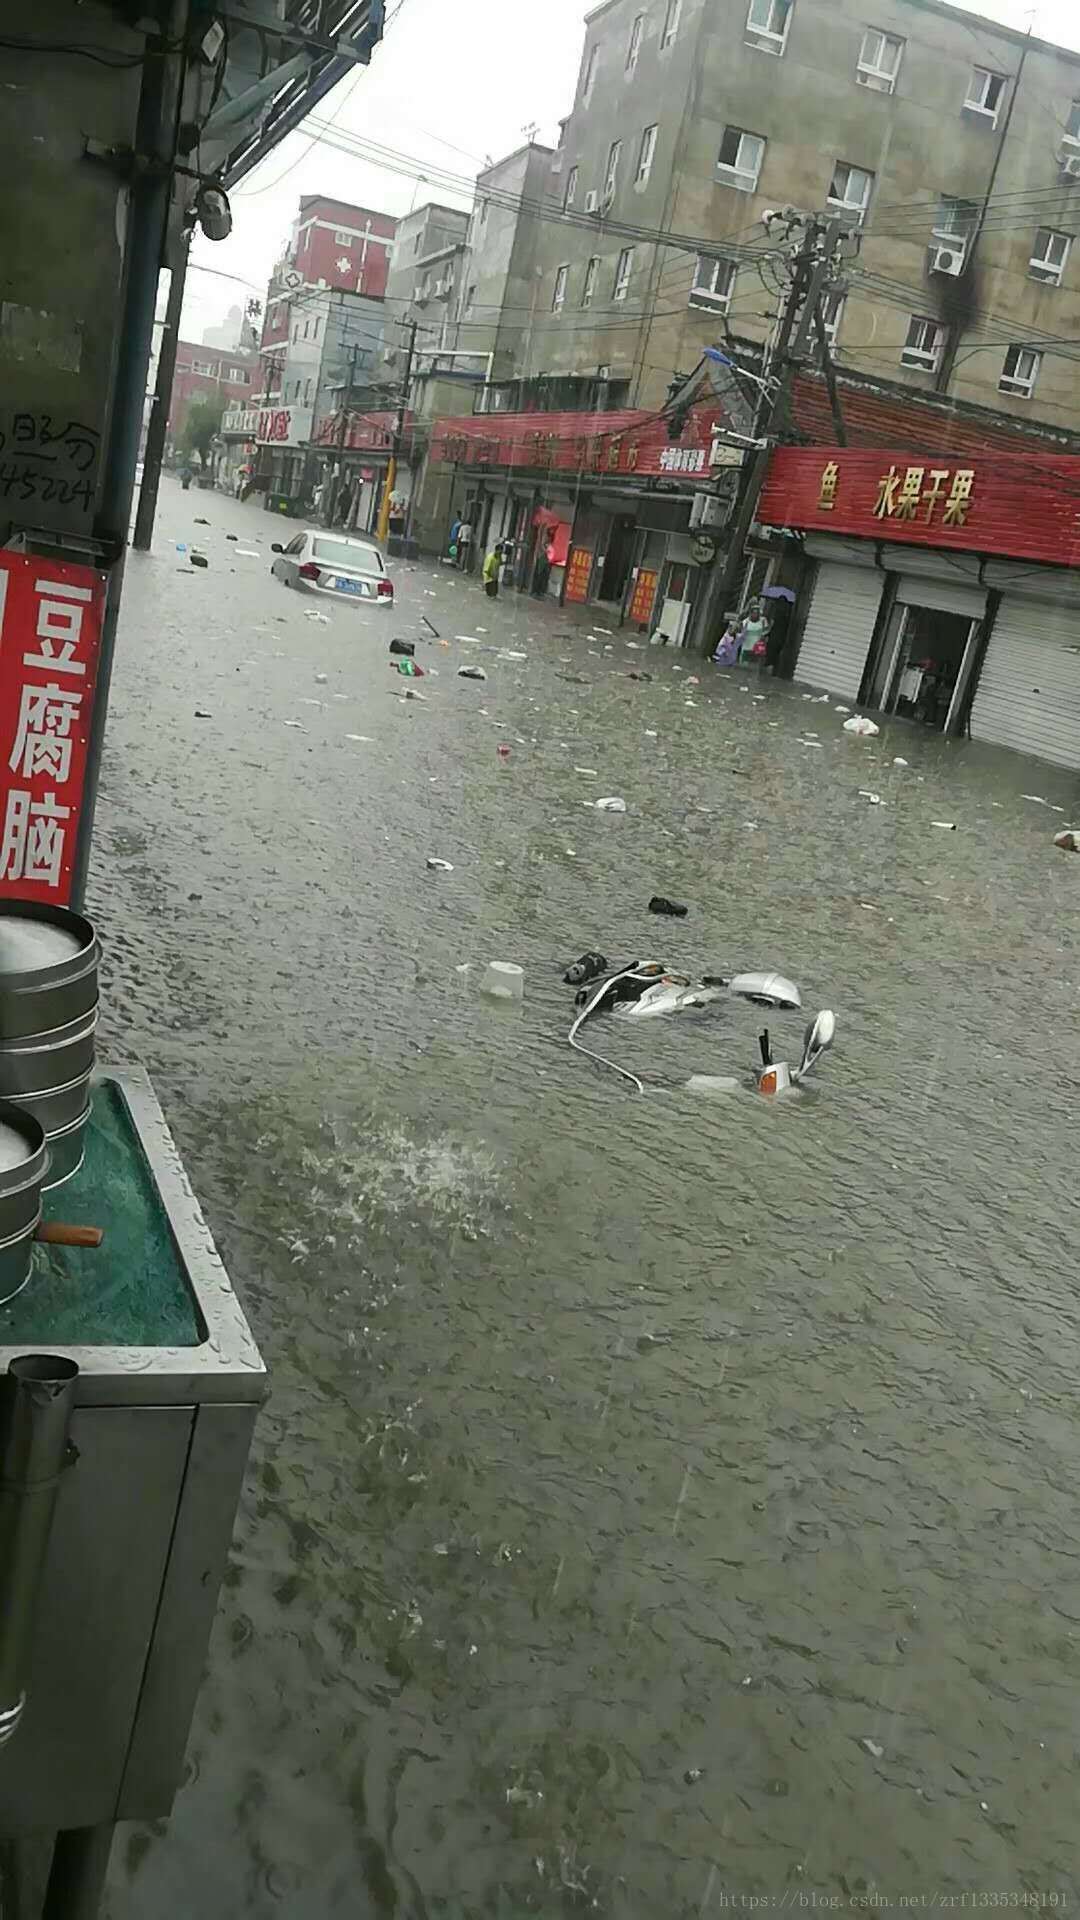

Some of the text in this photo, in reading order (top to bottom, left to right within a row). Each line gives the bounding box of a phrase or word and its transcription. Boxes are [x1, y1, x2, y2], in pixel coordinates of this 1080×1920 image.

[873, 465, 975, 526] 水果干果
[0, 578, 92, 888] 豆腐脑
